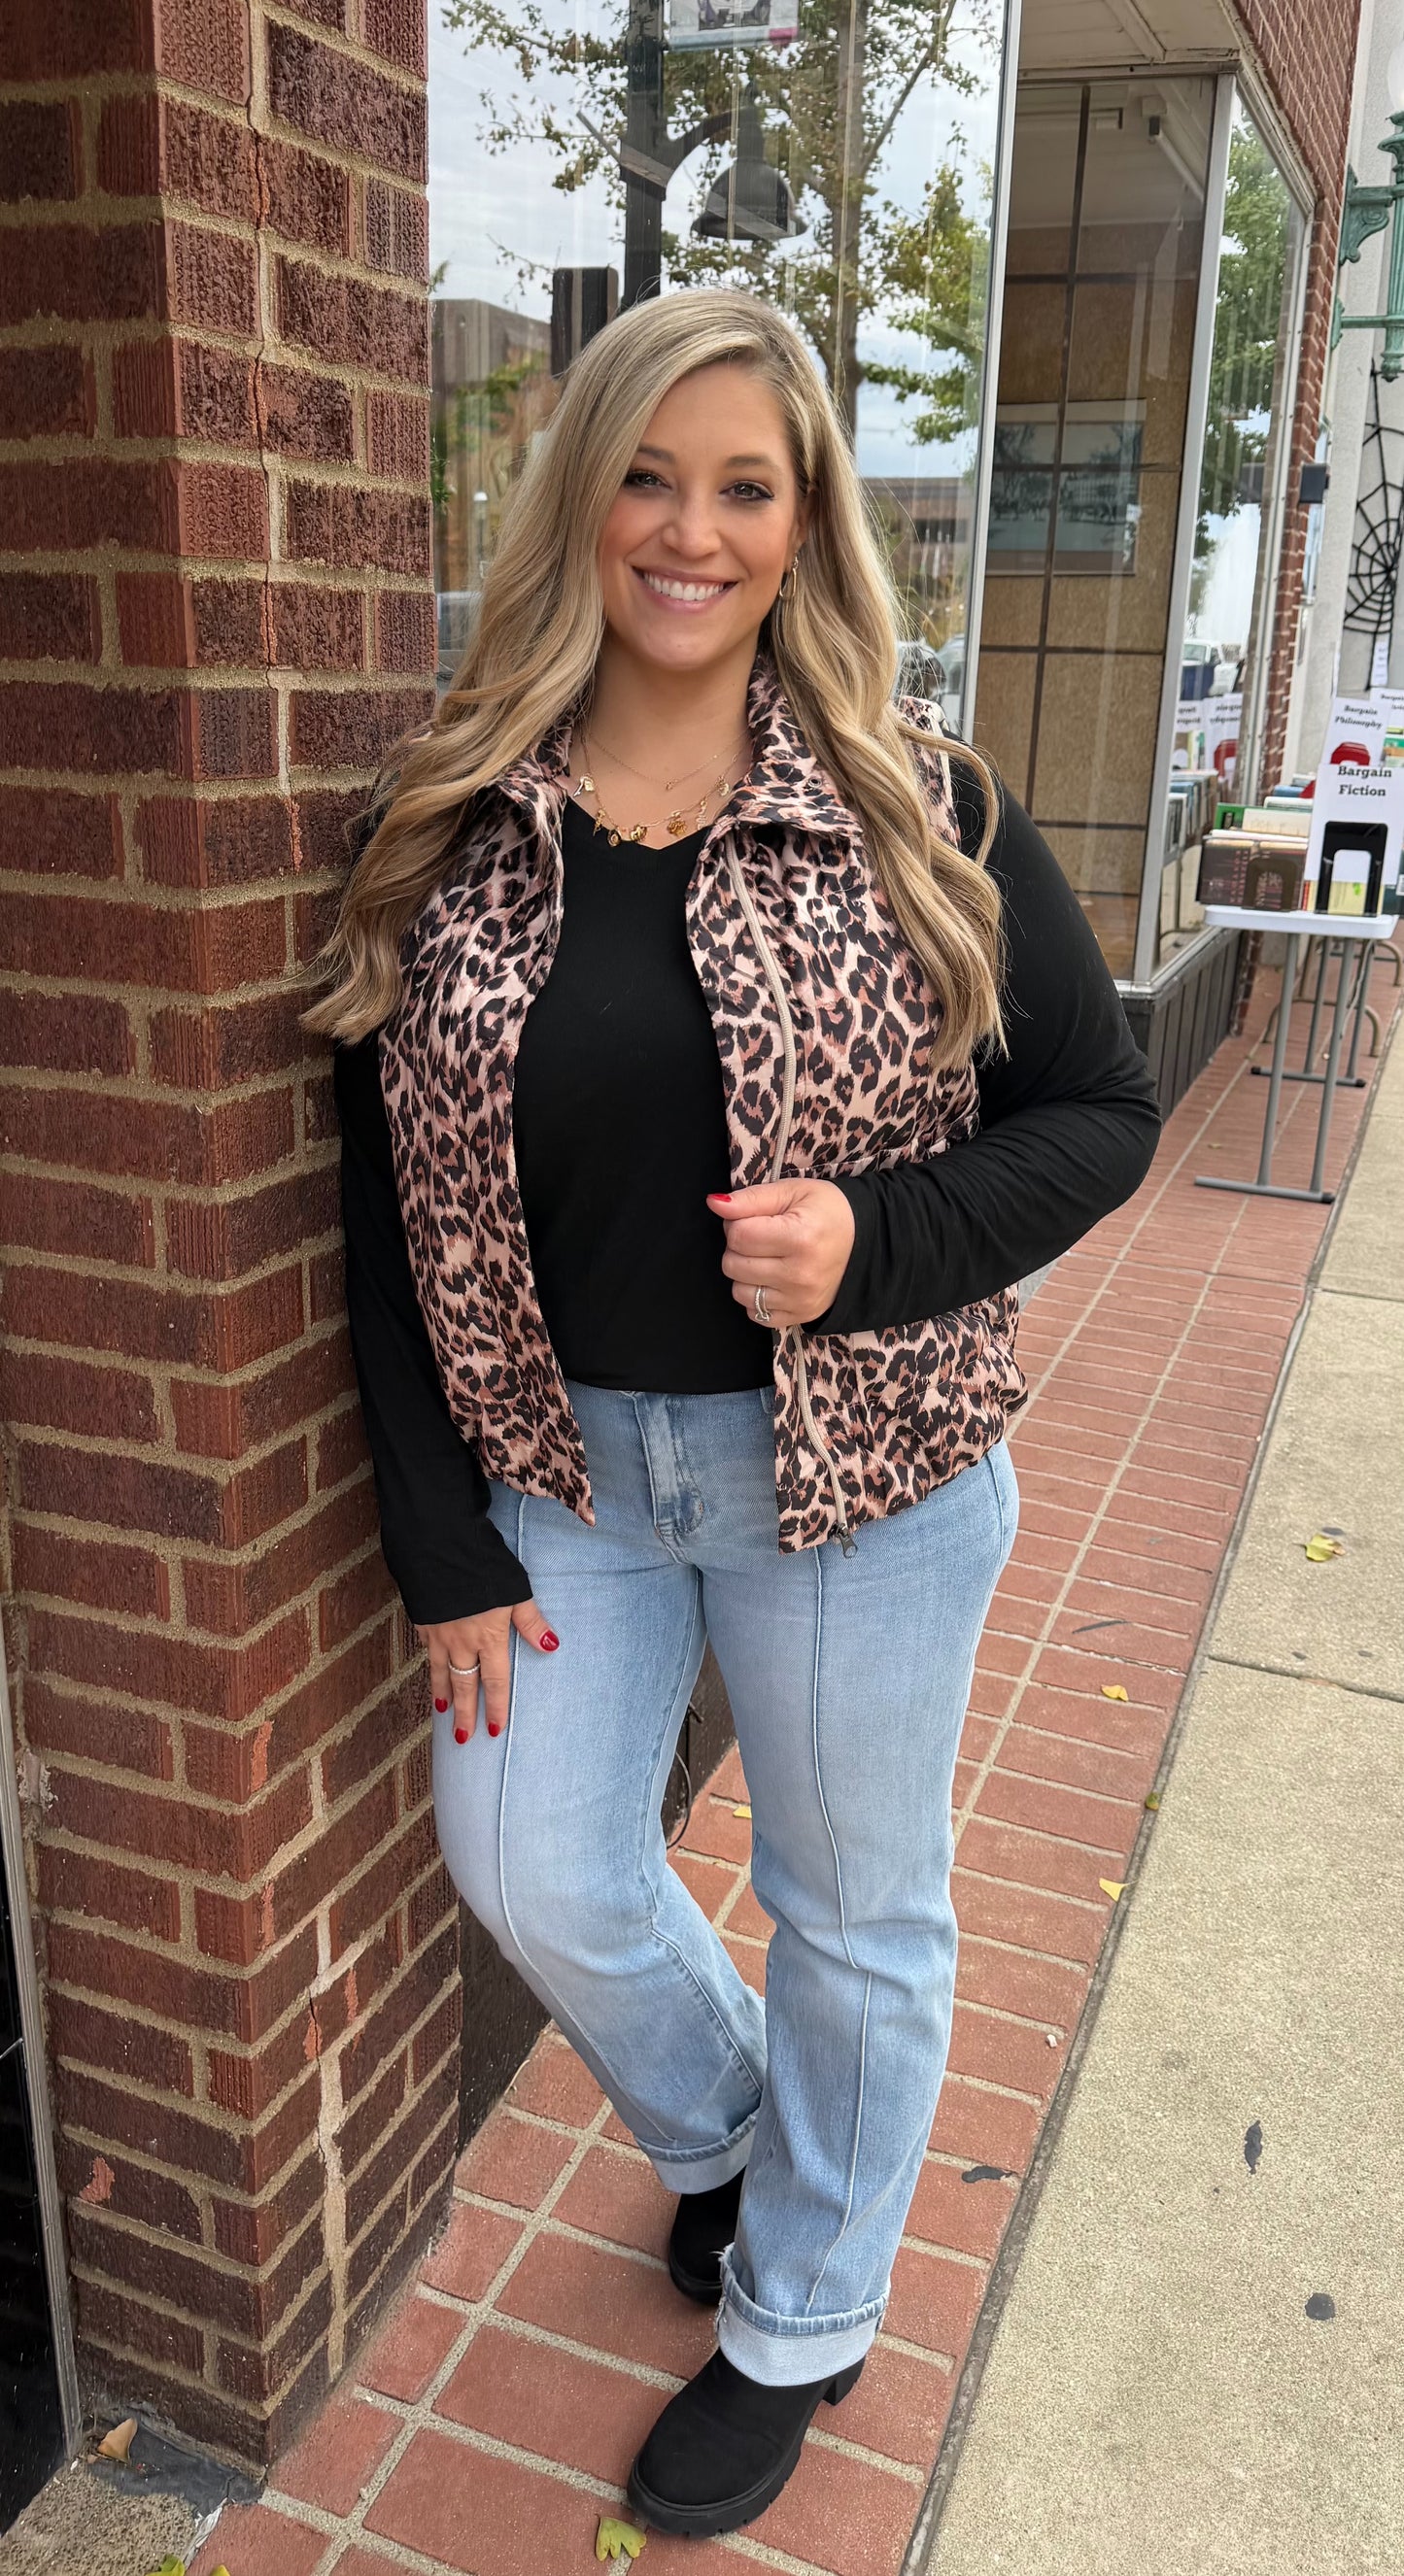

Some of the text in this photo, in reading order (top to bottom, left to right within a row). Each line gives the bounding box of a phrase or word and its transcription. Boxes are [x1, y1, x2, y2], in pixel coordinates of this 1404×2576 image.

[1344, 704, 1378, 715] Bargain
[1335, 716, 1383, 729] Philosophy
[1338, 765, 1392, 779] Bargain
[1339, 785, 1387, 797] Fiction
